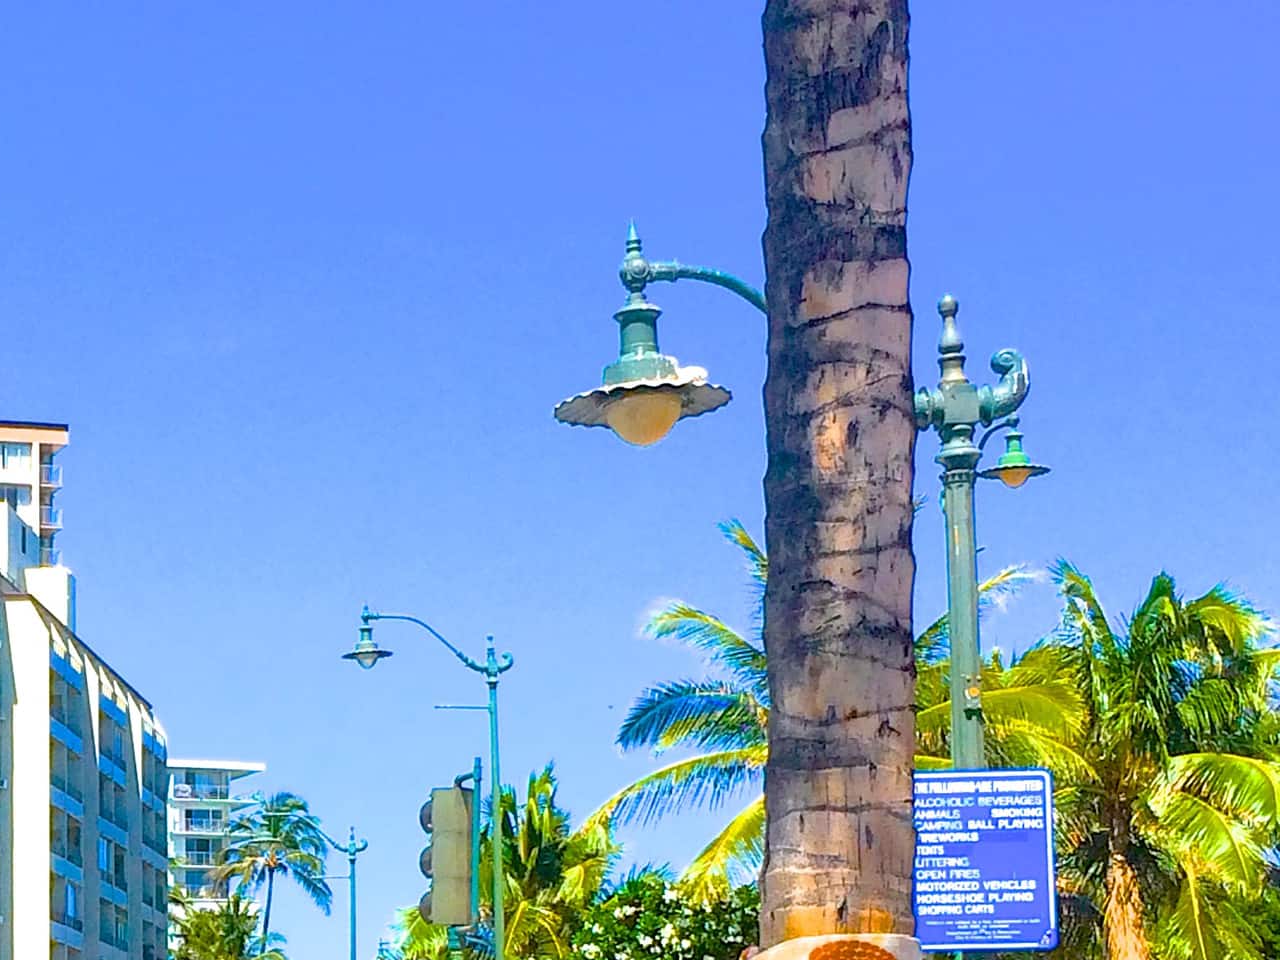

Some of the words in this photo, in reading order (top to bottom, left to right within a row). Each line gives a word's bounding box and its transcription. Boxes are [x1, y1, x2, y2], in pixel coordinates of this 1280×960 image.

[914, 797, 974, 808] ALCOHOLIC
[977, 795, 1043, 806] BEVERAGES
[914, 809, 961, 820] ANIMALS
[991, 807, 1044, 818] SMOKING
[914, 820, 963, 832] CAMPING
[968, 819, 996, 830] BALL
[998, 818, 1044, 829] PLAYING
[916, 845, 944, 855] TENTS
[915, 856, 970, 868] LITTERING
[916, 869, 947, 880] OPEN
[949, 868, 981, 879] FIRES
[916, 881, 980, 892] MOTORIZED
[983, 879, 1037, 891] VEHICLES
[916, 892, 985, 904] HORSESHOE
[988, 892, 1034, 903] PLAYING
[918, 904, 963, 916] SHOPPING
[964, 904, 995, 915] CARTS
